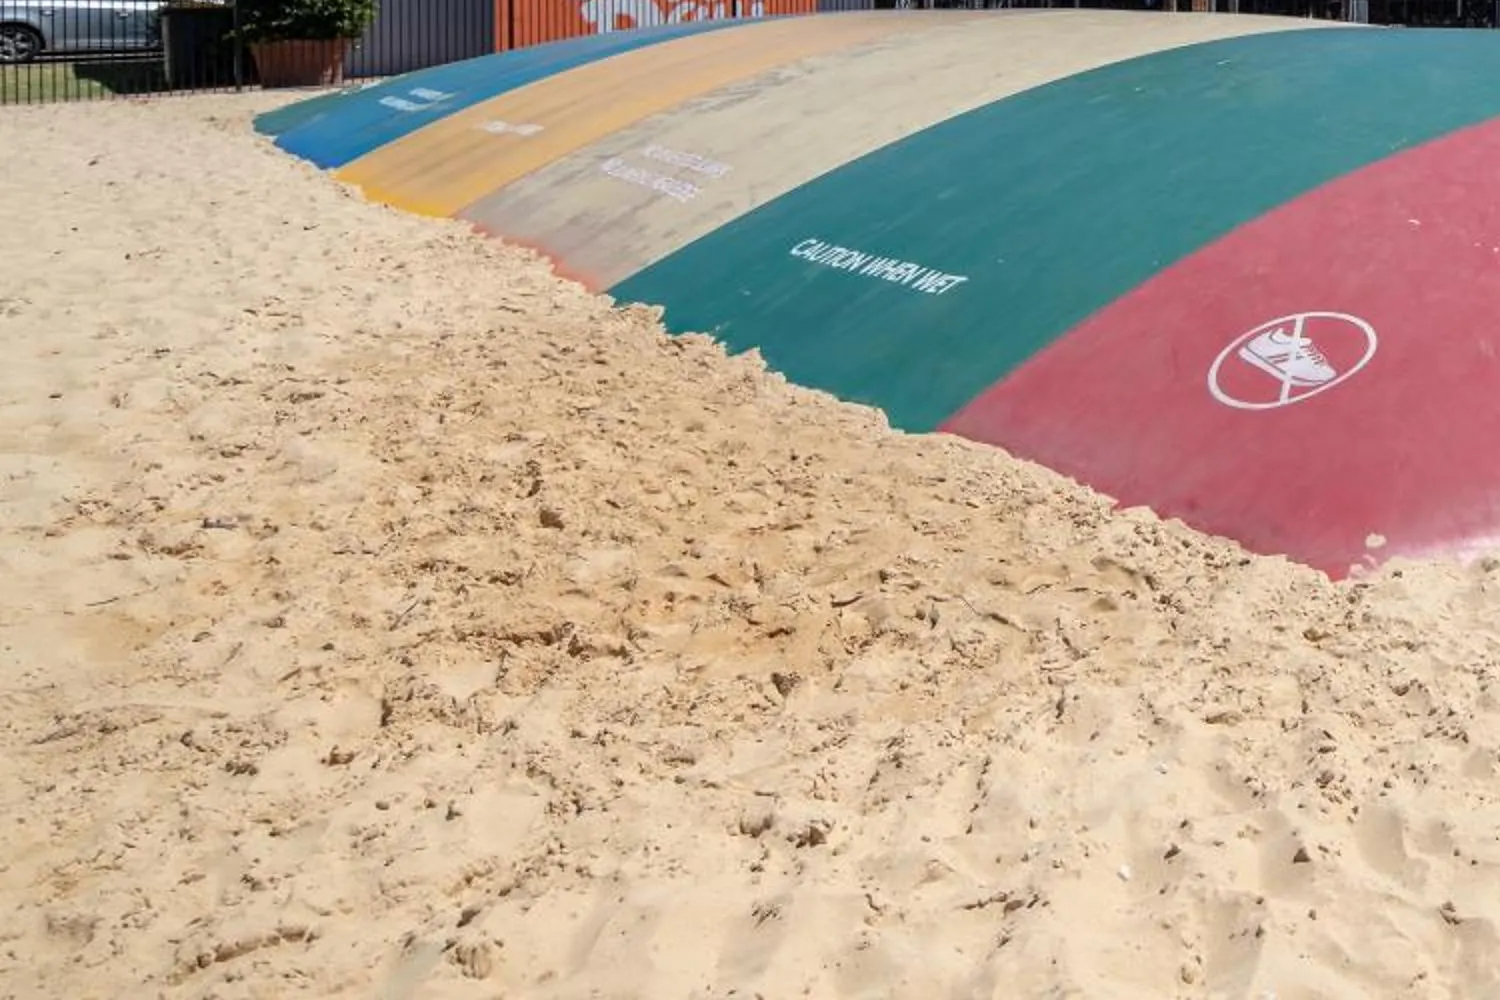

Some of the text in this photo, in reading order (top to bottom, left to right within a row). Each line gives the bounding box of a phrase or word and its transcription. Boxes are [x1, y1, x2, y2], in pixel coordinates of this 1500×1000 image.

[790, 238, 969, 295] CAUTION WHEN WET
